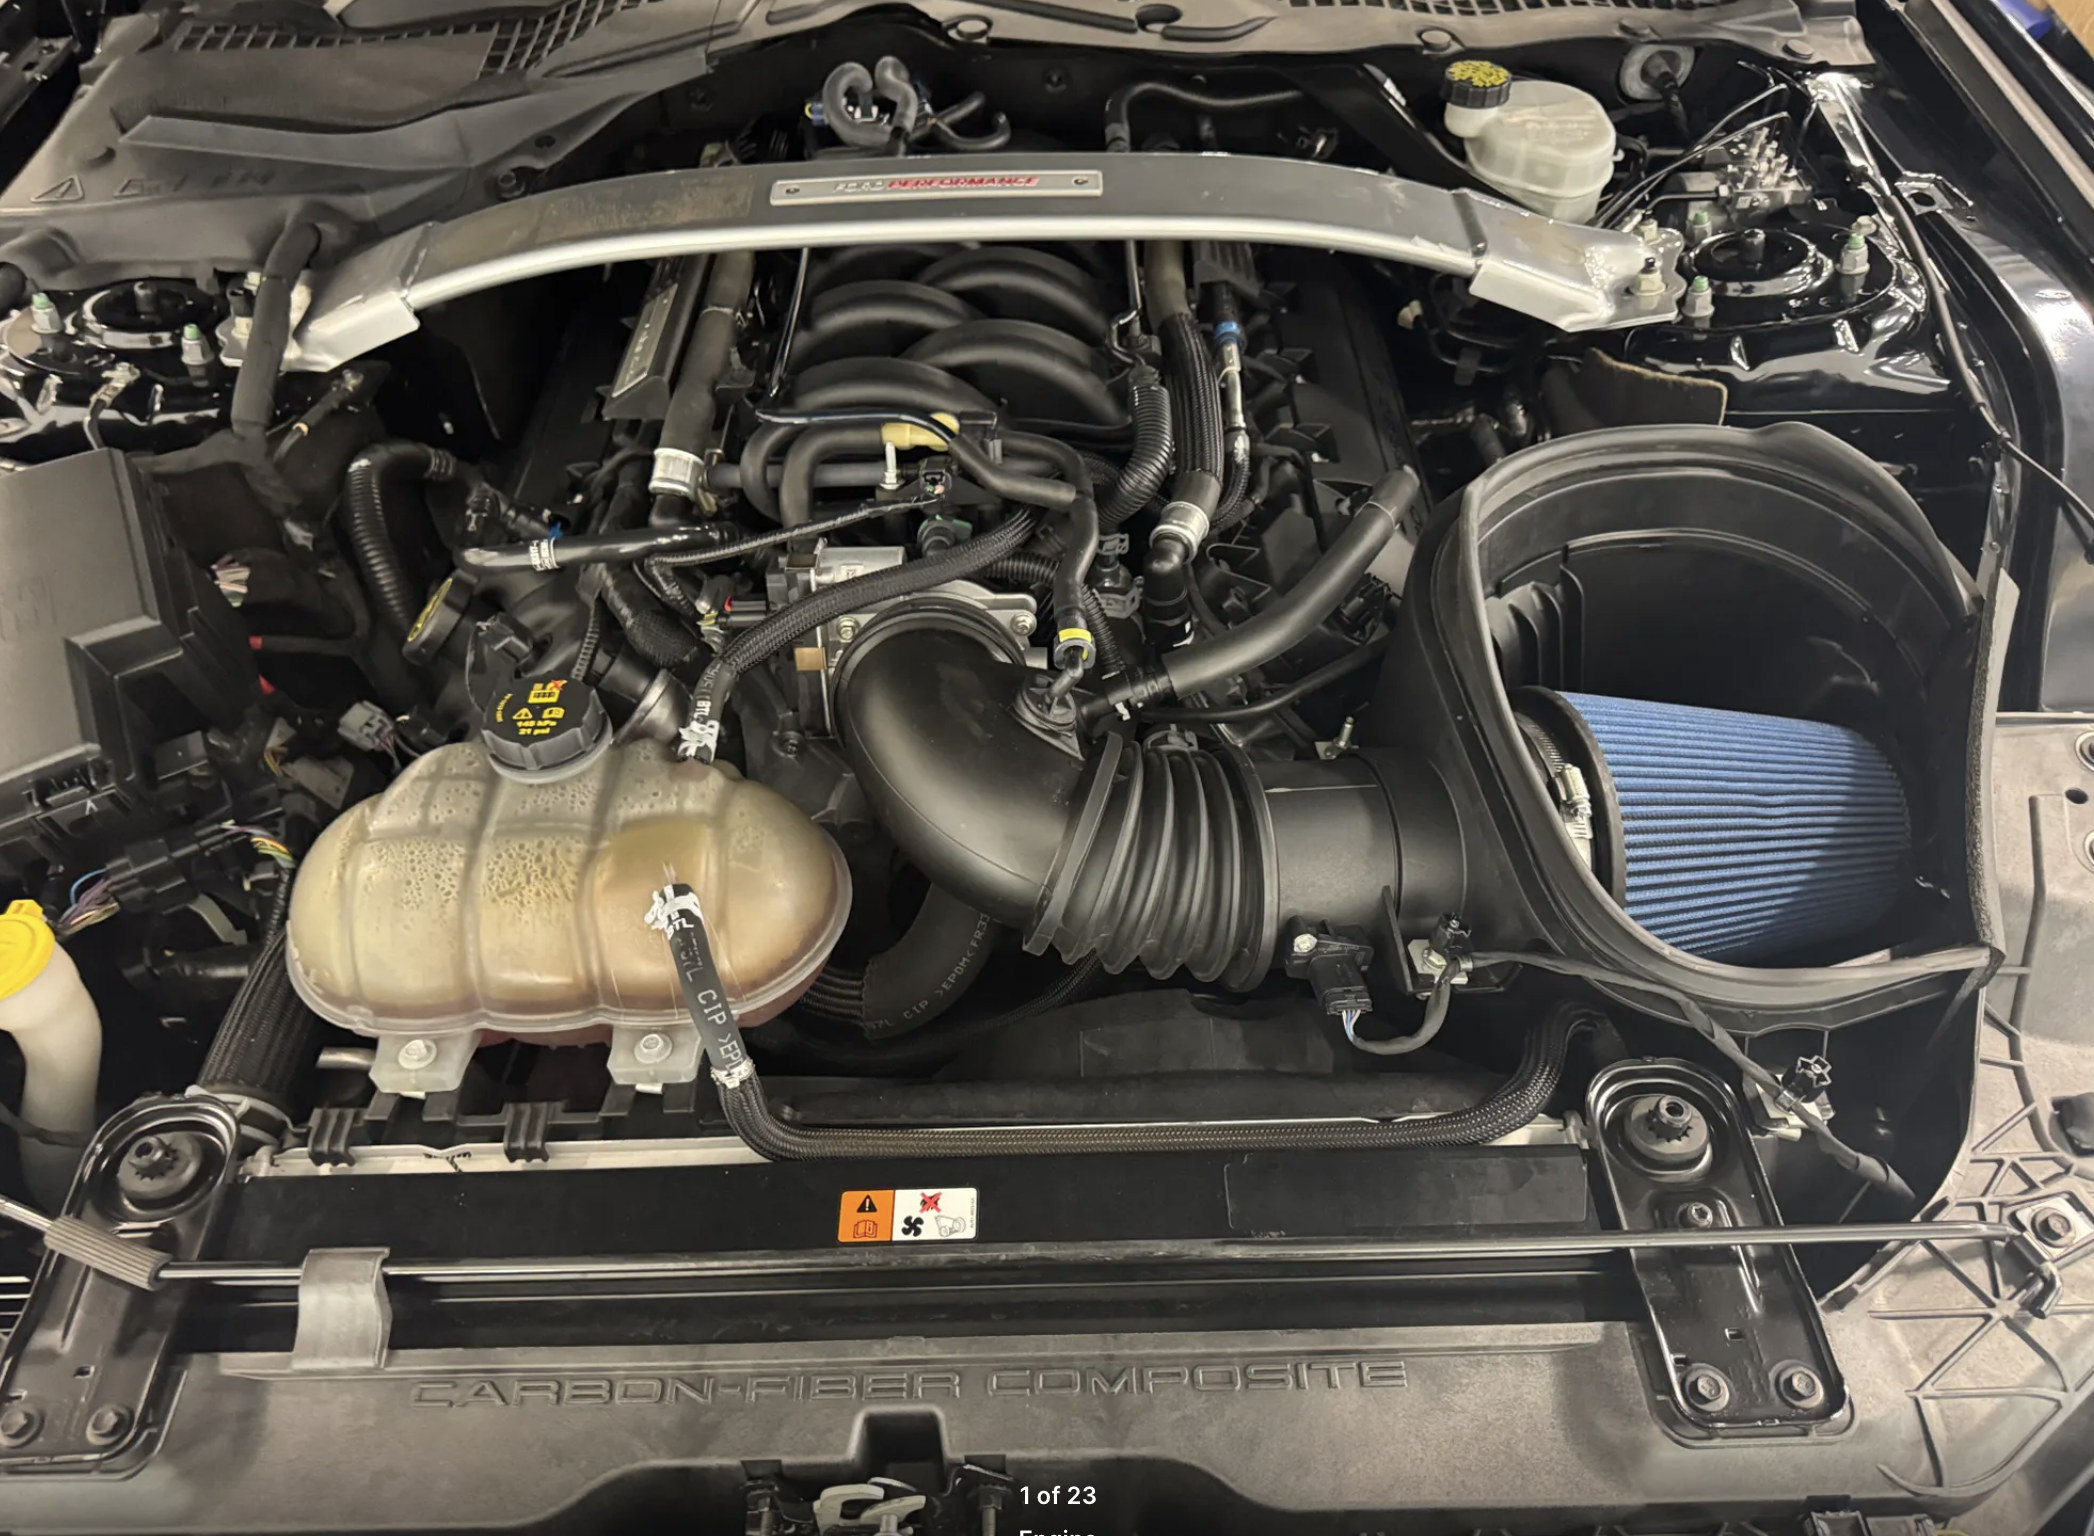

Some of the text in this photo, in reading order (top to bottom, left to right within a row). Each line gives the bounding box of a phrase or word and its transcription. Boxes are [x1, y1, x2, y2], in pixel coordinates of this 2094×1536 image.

[888, 176, 1040, 189] PERFORMANCE
[697, 988, 728, 1026] CIP
[409, 1359, 1409, 1408] CARBON-FIBER COMPOSITE
